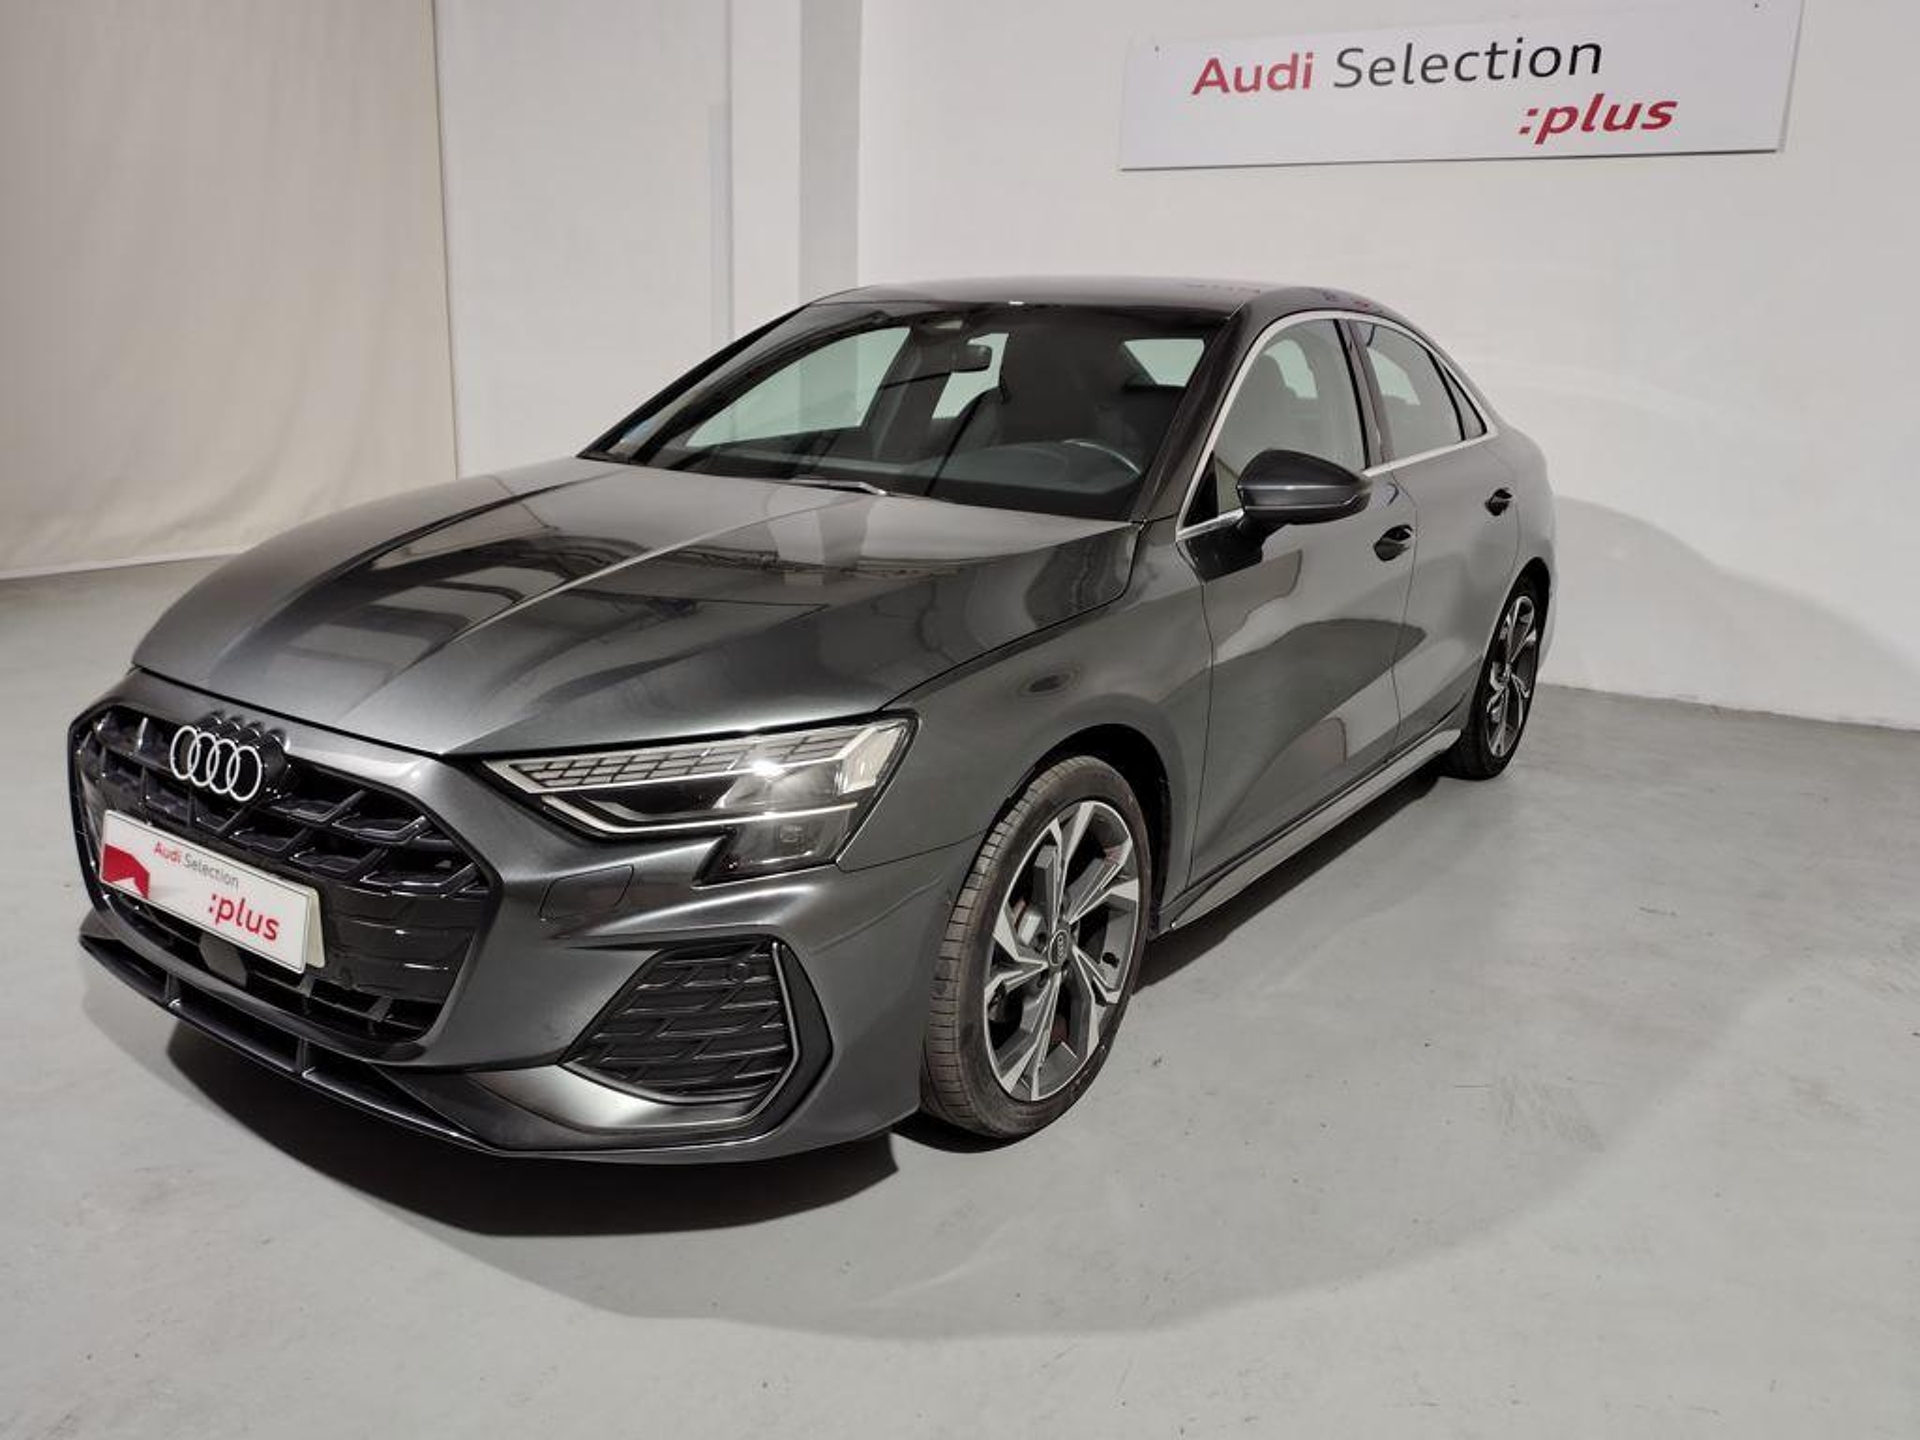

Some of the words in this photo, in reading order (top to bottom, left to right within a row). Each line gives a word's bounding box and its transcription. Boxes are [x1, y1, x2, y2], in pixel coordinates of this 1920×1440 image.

[1192, 53, 1314, 95] Audi
[1333, 37, 1602, 88] Selection
[1518, 94, 1678, 145] :plus
[154, 841, 181, 864] Audi
[184, 854, 239, 888] Selection
[208, 893, 280, 941] :plus
